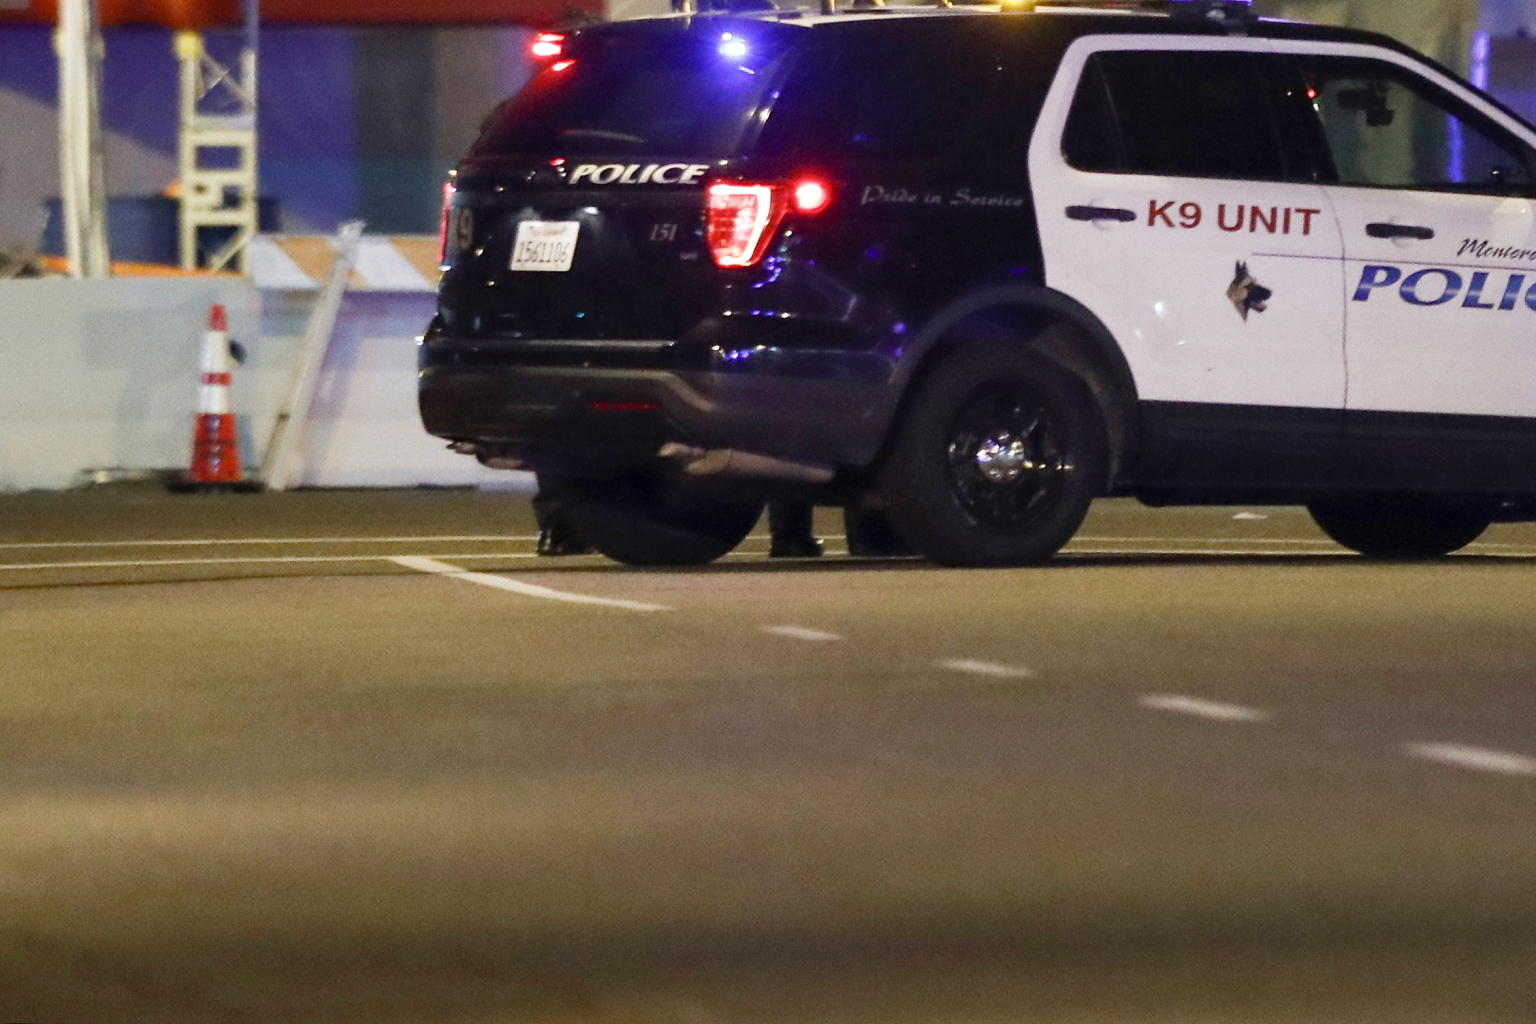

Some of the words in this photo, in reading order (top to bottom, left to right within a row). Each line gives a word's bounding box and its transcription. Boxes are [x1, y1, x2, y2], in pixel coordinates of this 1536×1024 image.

[568, 163, 709, 185] POLICE
[860, 184, 918, 206] Pride
[923, 192, 942, 205] in
[949, 188, 1024, 207] Service
[1147, 199, 1203, 229] K9
[1217, 203, 1321, 236] UNIT
[650, 223, 678, 241] 151
